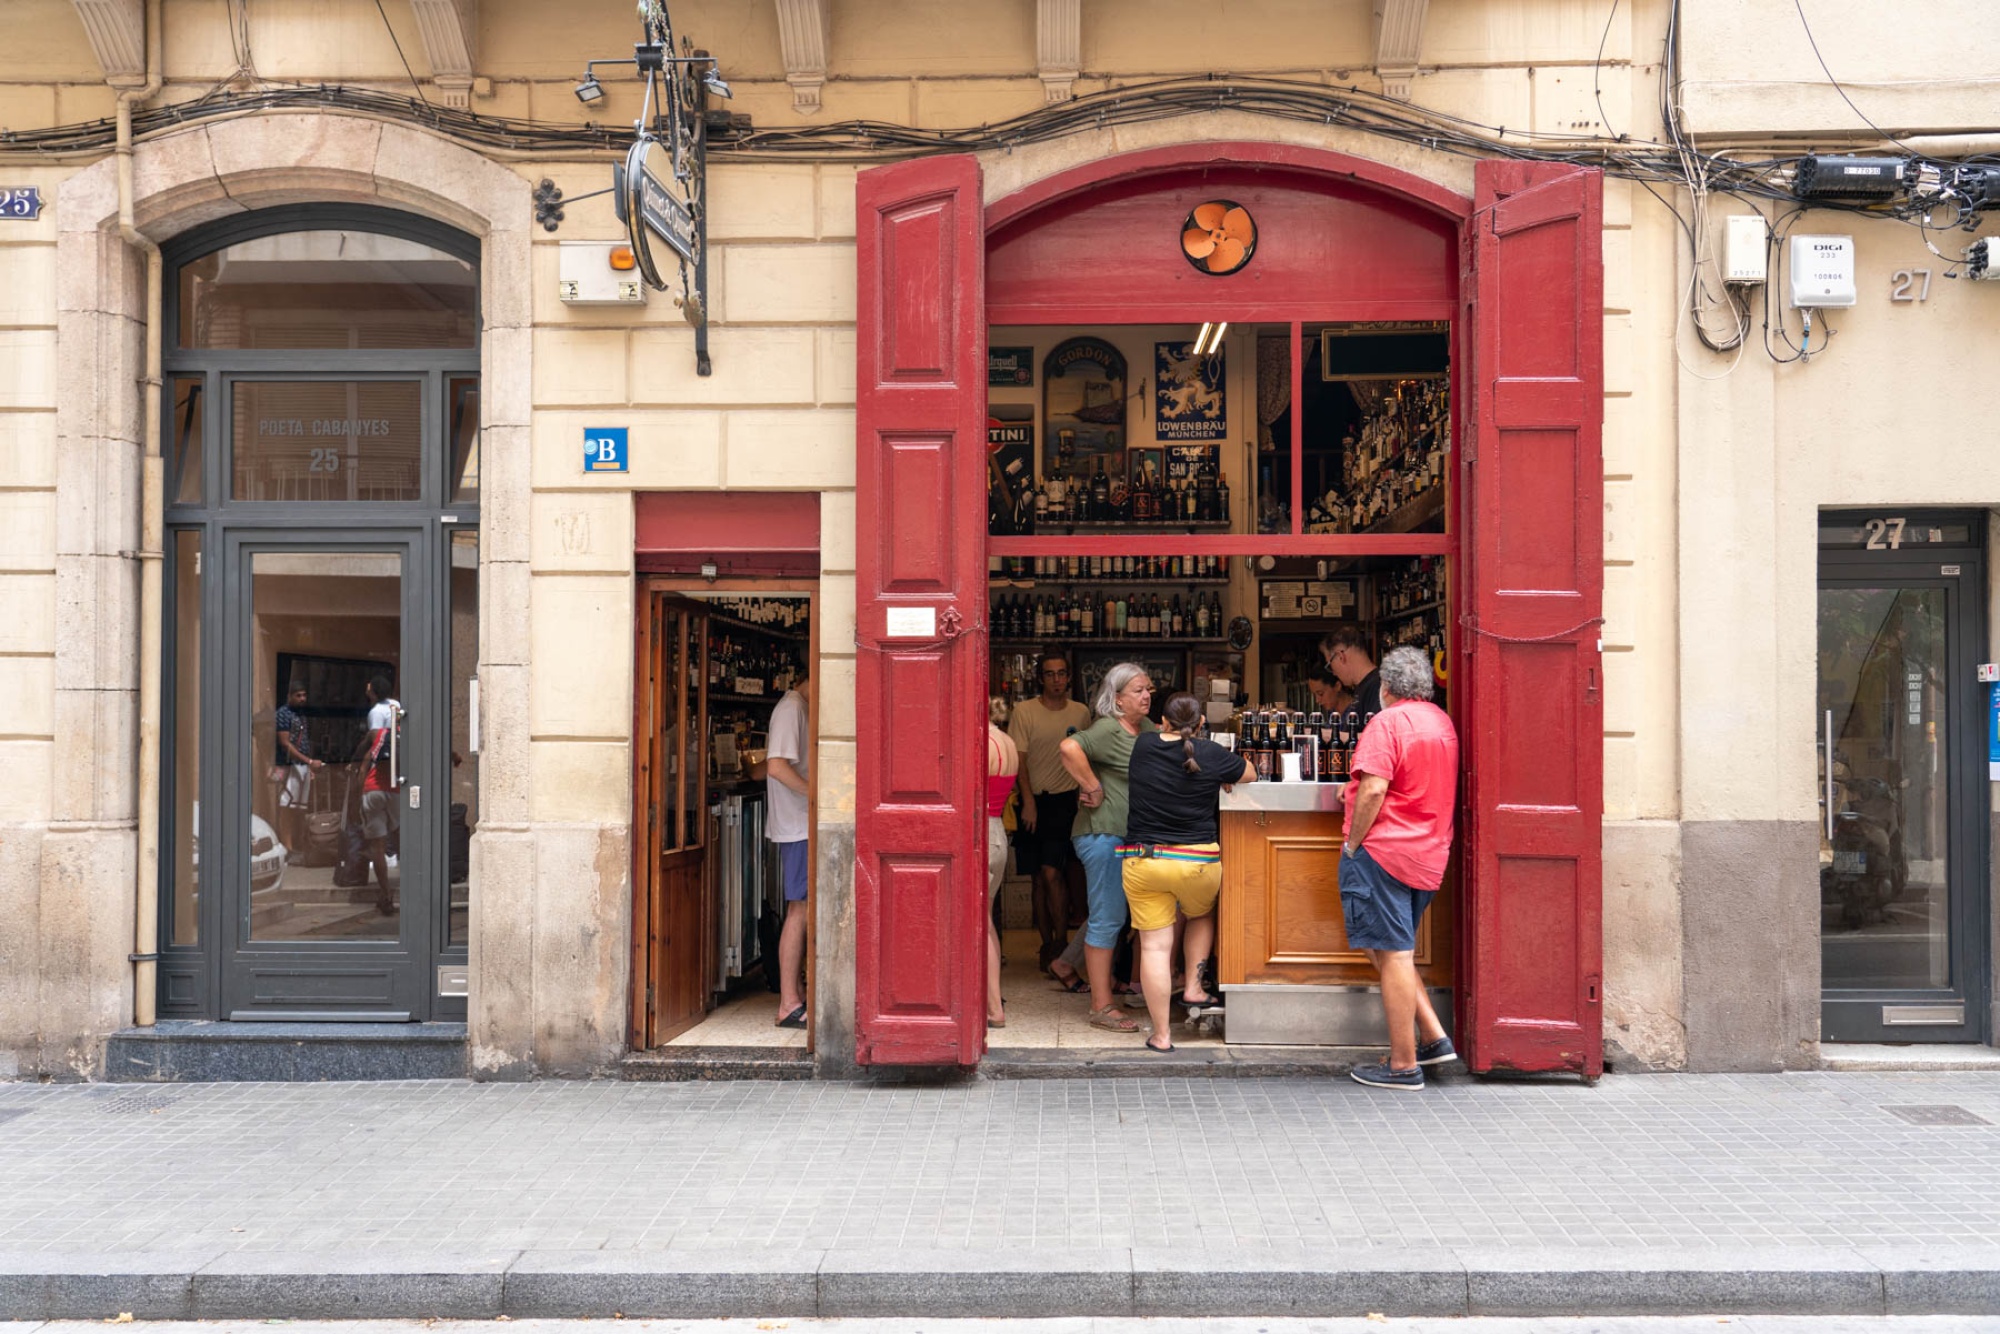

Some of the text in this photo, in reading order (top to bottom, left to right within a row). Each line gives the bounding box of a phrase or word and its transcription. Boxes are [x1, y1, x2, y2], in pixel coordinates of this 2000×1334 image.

[0, 190, 30, 215] 25
[1891, 268, 1932, 302] 27
[1058, 345, 1112, 367] GORDON
[259, 420, 390, 435] POETA CABANYES
[988, 429, 1025, 441] TINI
[309, 448, 339, 472] 25
[597, 438, 616, 461] B
[1169, 462, 1186, 476] SAN
[1865, 517, 1907, 550] 27
